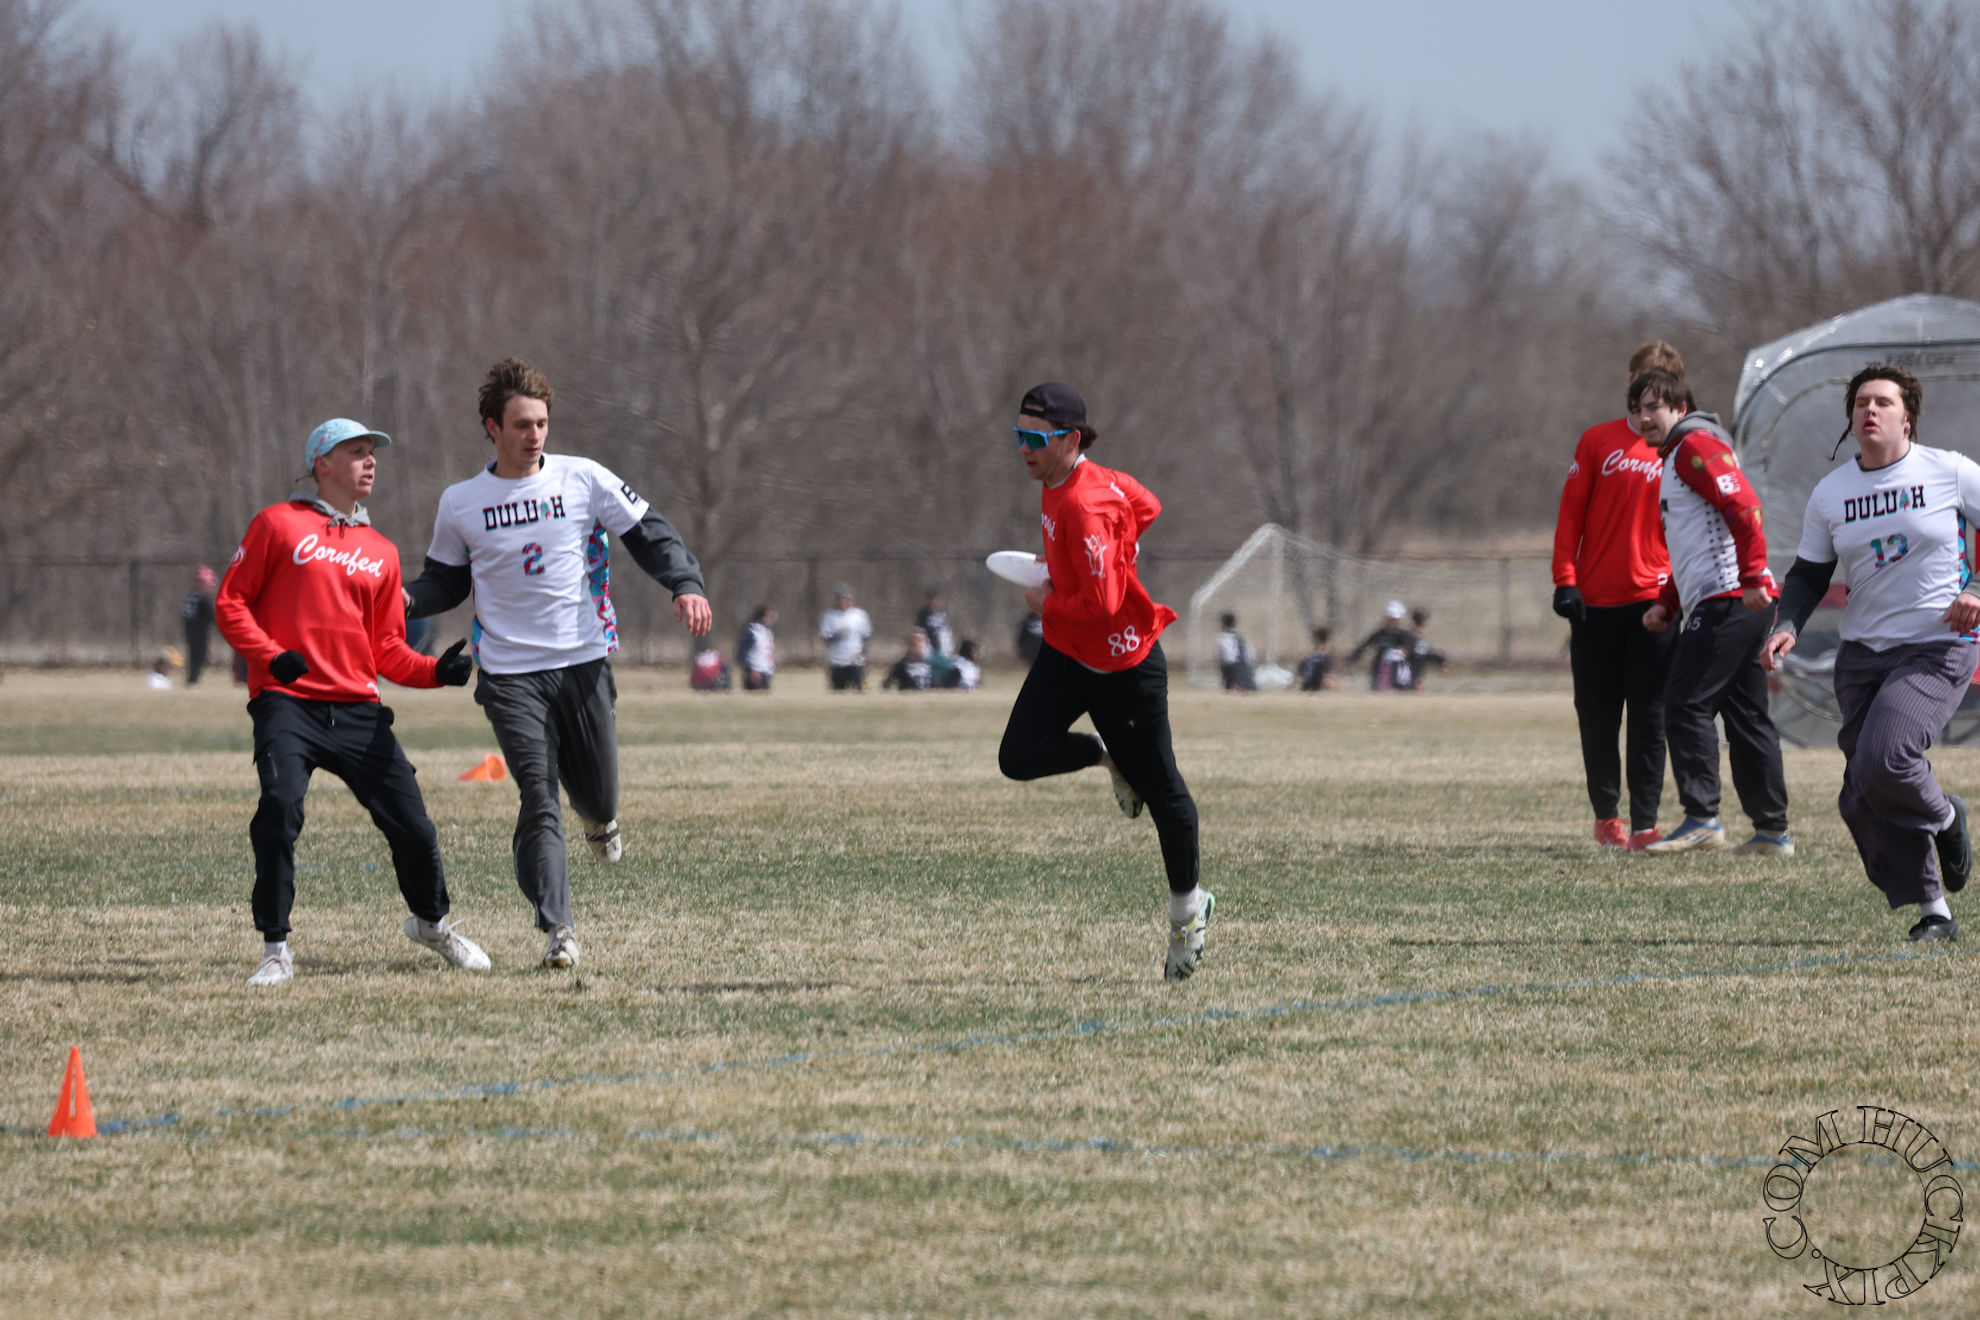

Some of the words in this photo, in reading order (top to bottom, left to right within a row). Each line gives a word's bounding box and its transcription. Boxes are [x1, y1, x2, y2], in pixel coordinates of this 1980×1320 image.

[292, 533, 385, 578] Cornfed
[521, 542, 546, 576] 2
[1107, 624, 1140, 657] 88
